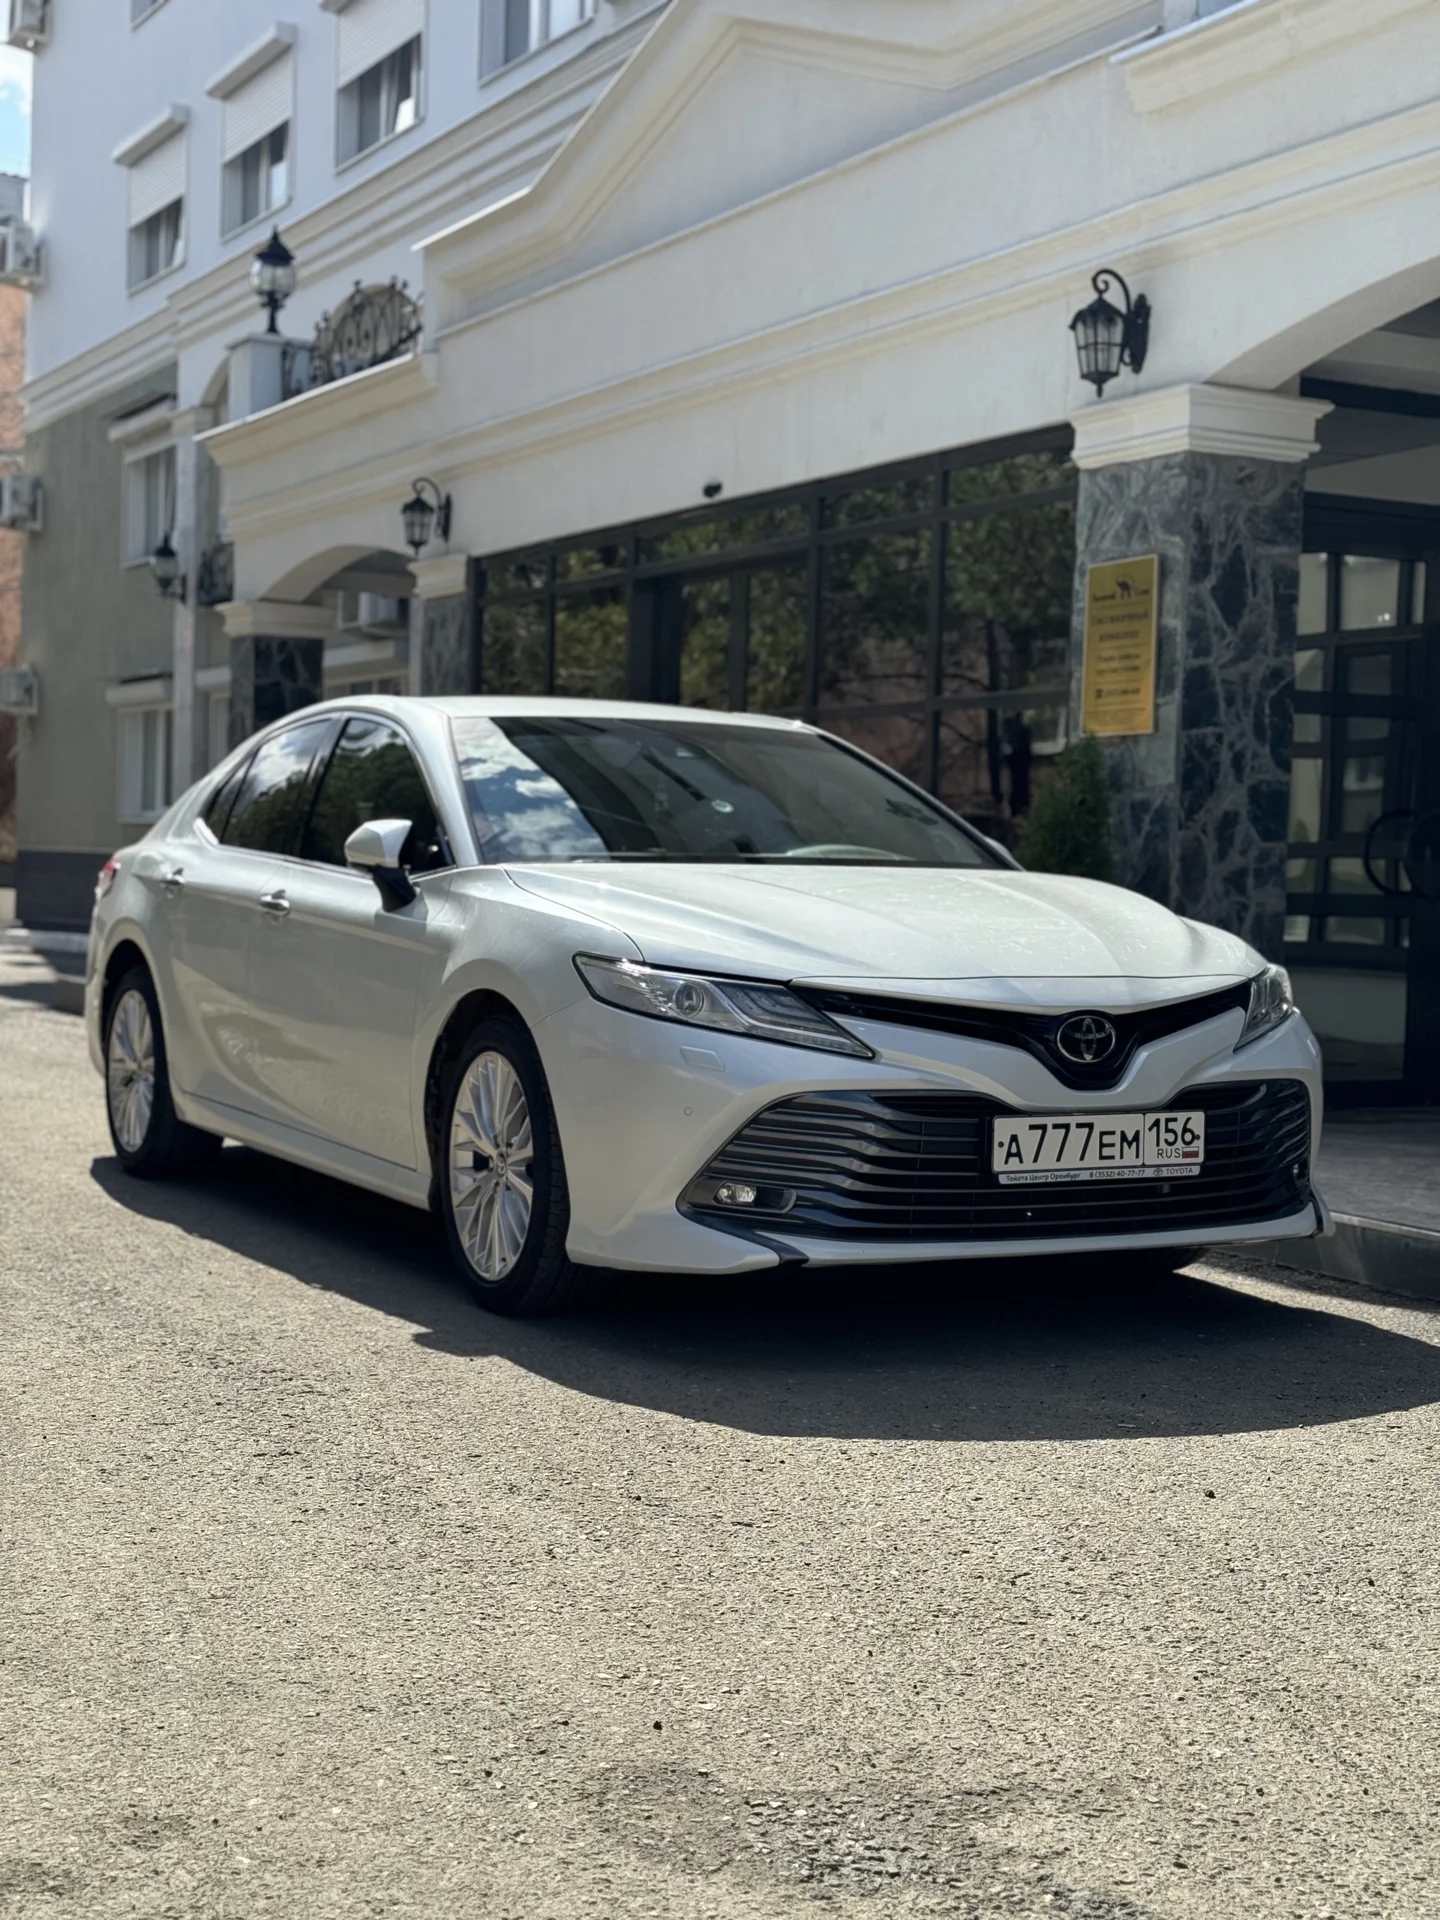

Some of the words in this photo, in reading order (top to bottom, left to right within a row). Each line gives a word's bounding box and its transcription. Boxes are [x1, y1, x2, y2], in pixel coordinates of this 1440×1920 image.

[1147, 1116, 1196, 1148] 156
[1003, 1122, 1141, 1165] А777ЕМ
[1156, 1147, 1181, 1159] RUS
[1006, 1174, 1029, 1183] Тойота
[1029, 1173, 1049, 1183] Центр
[1050, 1171, 1081, 1181] Оренбург
[1116, 1169, 1146, 1177] 40-77-77
[1165, 1167, 1194, 1175] TOYOTA
